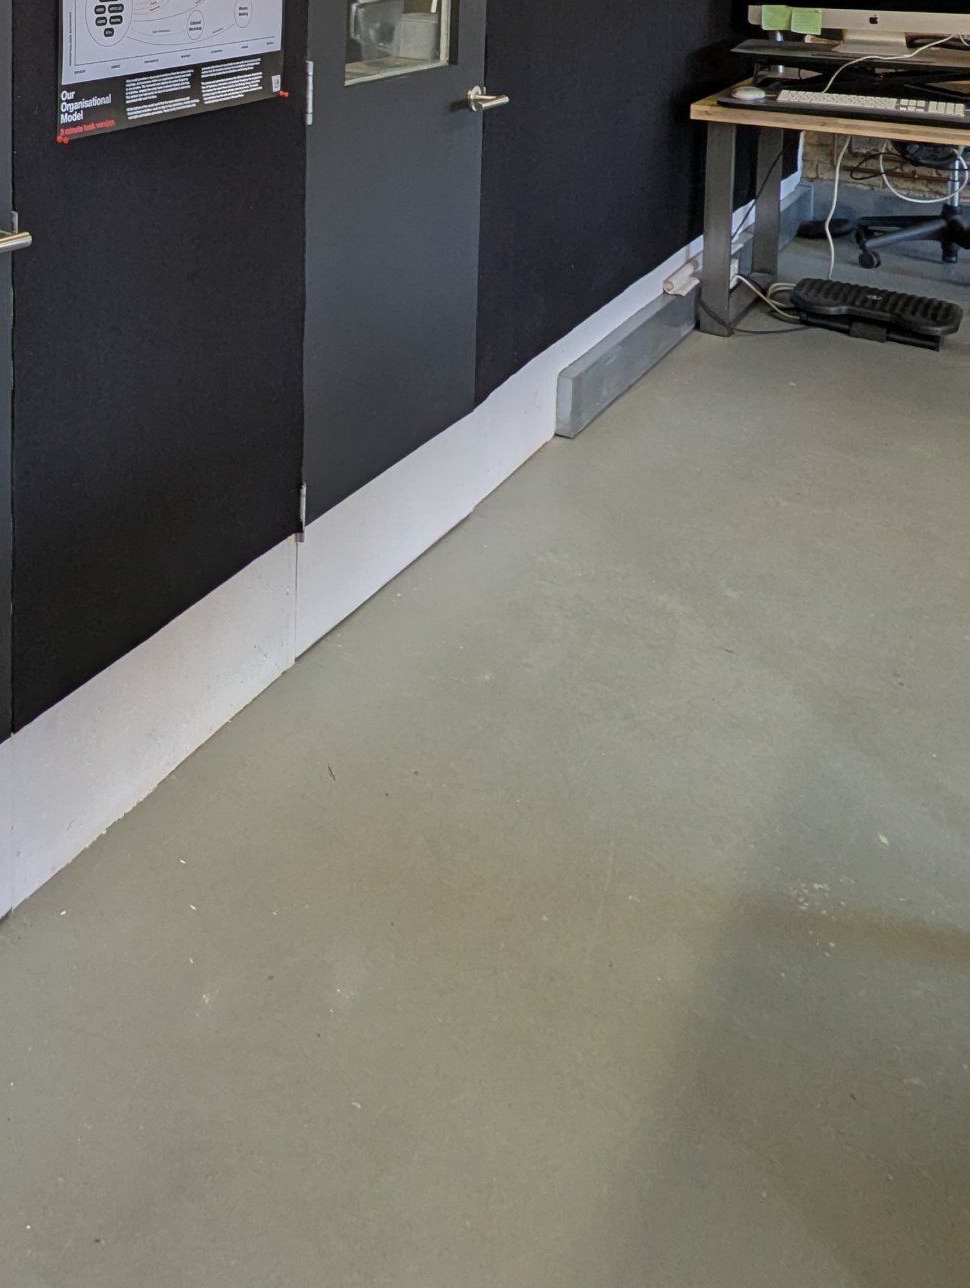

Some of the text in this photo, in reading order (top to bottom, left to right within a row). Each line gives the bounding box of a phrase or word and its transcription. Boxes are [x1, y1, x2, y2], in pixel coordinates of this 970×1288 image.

[60, 90, 76, 101] Our
[60, 93, 112, 113] Organisational
[60, 110, 84, 124] Model
